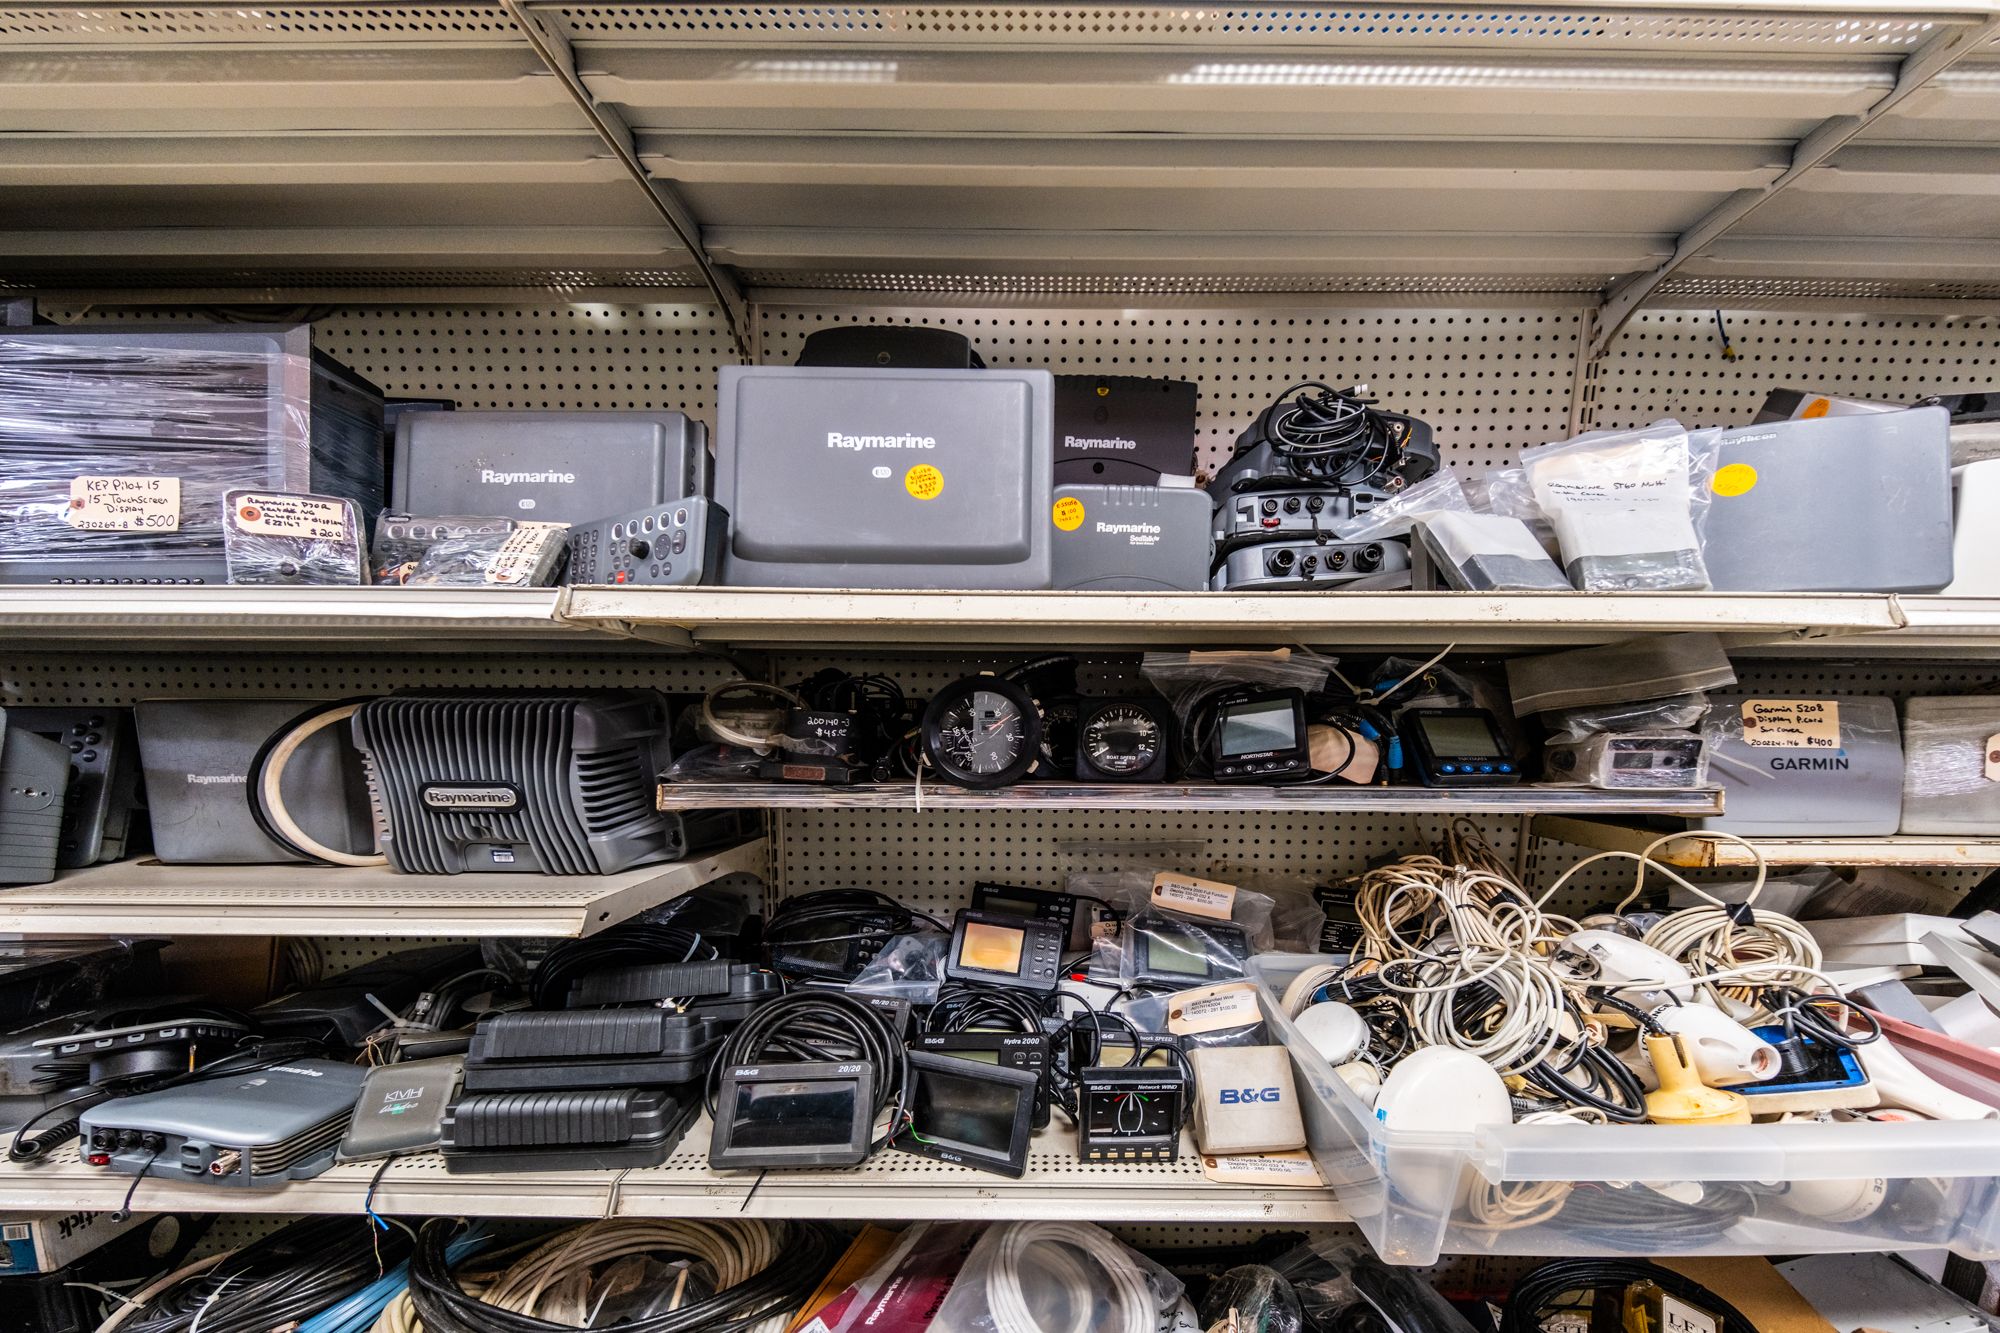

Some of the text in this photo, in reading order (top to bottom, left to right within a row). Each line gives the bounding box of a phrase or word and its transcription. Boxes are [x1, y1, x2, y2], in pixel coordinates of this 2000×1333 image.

[827, 432, 936, 451] Raymarine
[1065, 435, 1136, 450] Raymarine
[482, 469, 575, 485] Raymarine
[86, 479, 160, 491] KEP Pilot 15
[108, 493, 169, 505] TouchScreen
[103, 503, 144, 514] Display
[134, 514, 175, 527] $500
[1096, 521, 1161, 534] Raymarine
[1753, 703, 1825, 714] Garmin 5208
[1756, 715, 1792, 724] Display
[1138, 743, 1146, 751] 12
[1807, 736, 1833, 747] $400
[1240, 751, 1274, 760] NORTHSTAR
[1770, 757, 1849, 770] GARMIN
[428, 791, 511, 805] Raymarine
[1211, 891, 1228, 899] Function
[1003, 1037, 1040, 1045] Hydra 2000
[838, 1064, 861, 1073] 20/20
[1219, 1087, 1280, 1105] B&G
[940, 1152, 962, 1162] B&G
[864, 1275, 904, 1326] Raymarine
